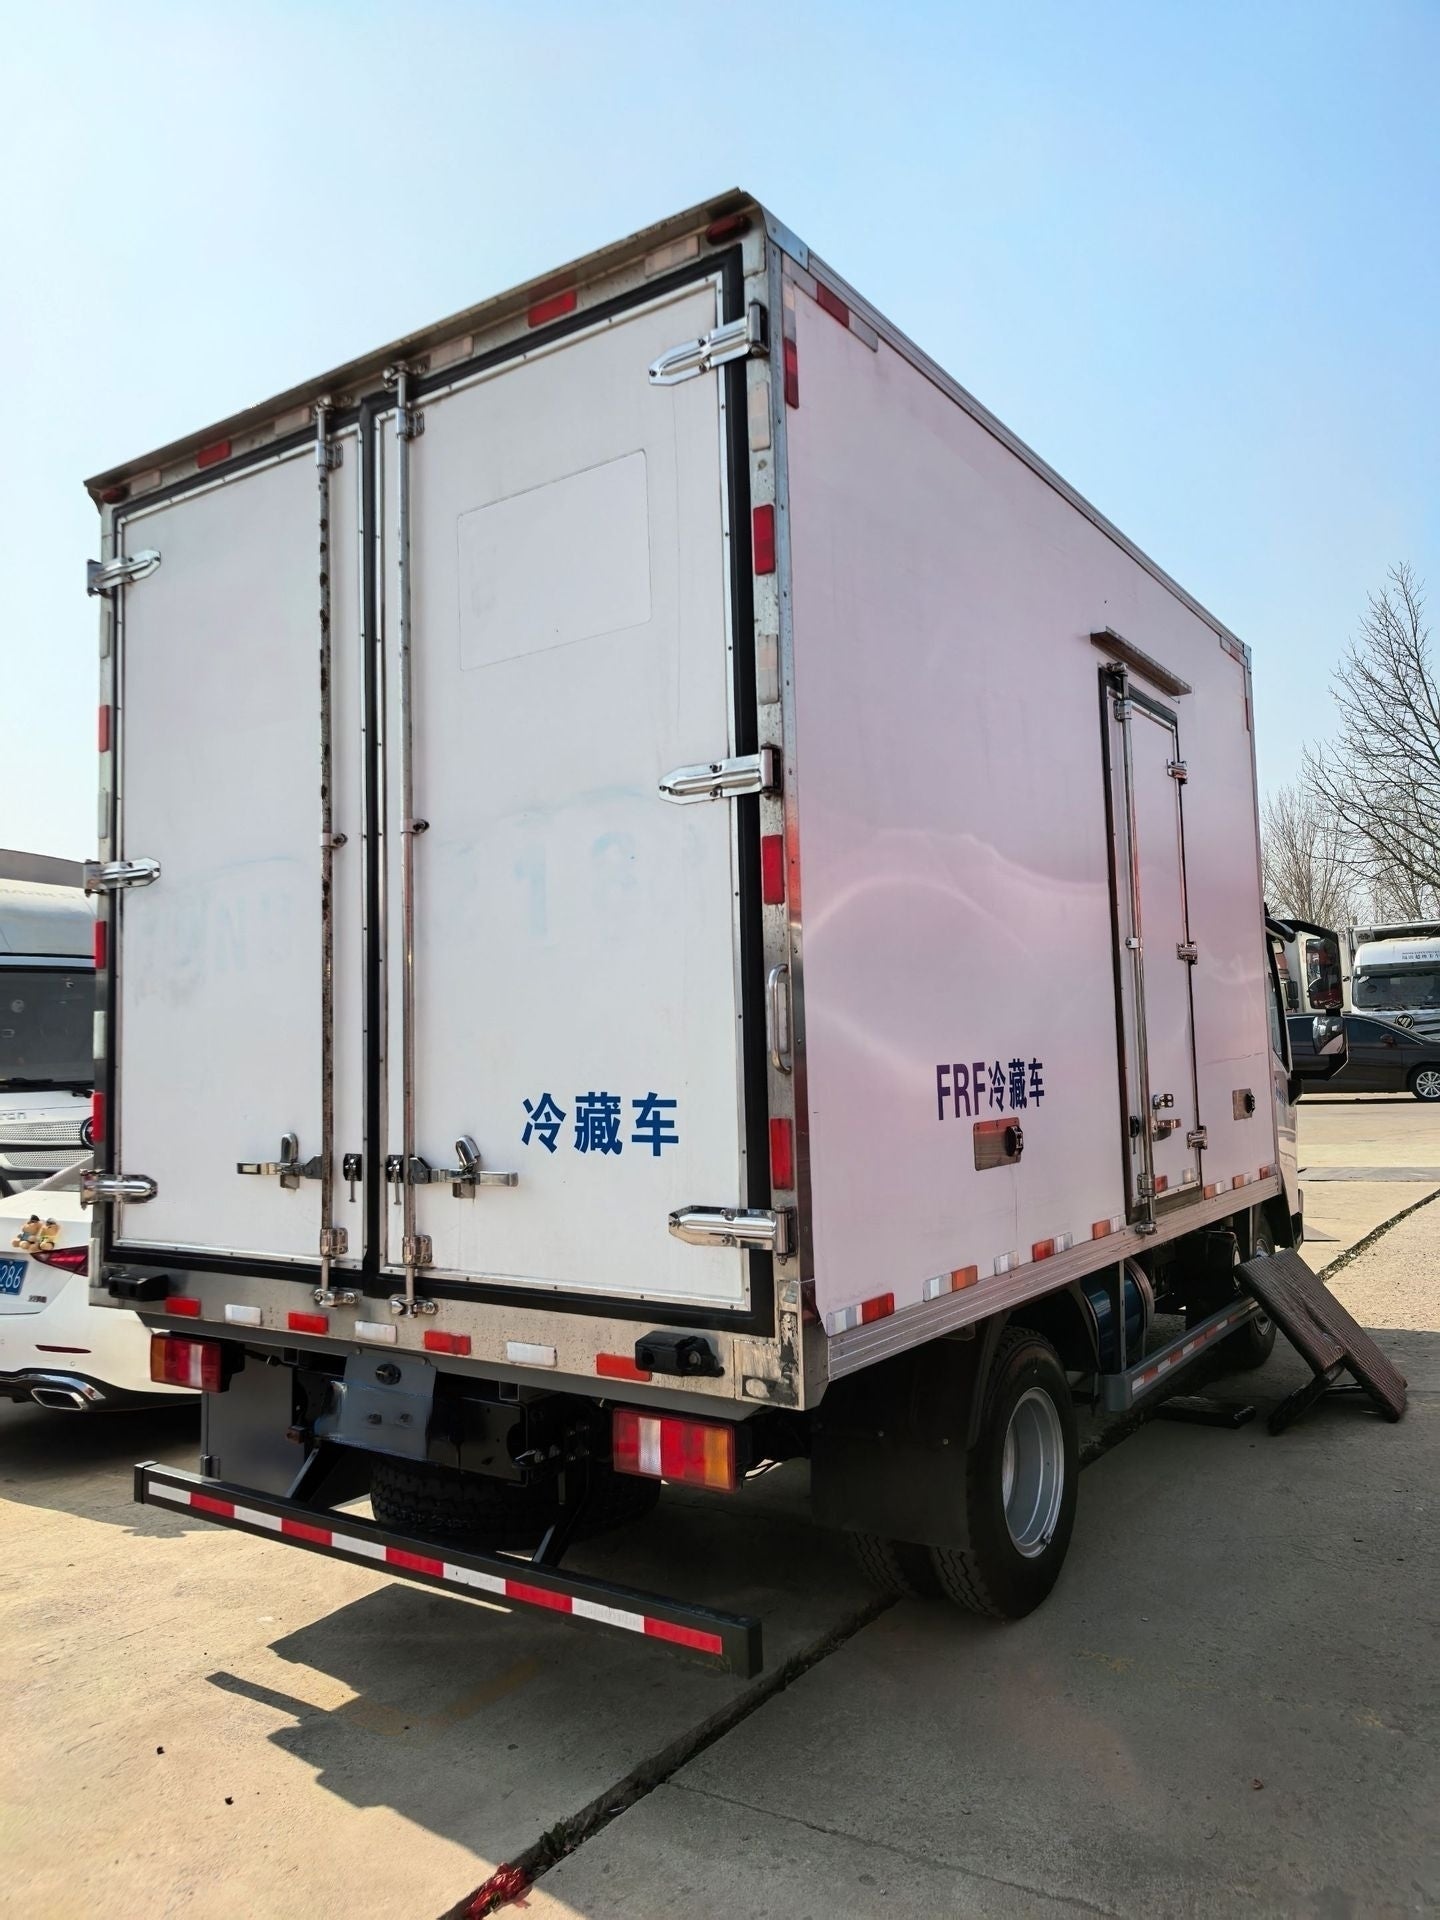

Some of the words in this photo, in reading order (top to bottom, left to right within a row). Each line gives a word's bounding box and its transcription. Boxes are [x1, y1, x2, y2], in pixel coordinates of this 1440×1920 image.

[936, 1058, 1045, 1120] FRF冷藏车
[521, 1092, 679, 1157] 冷藏车
